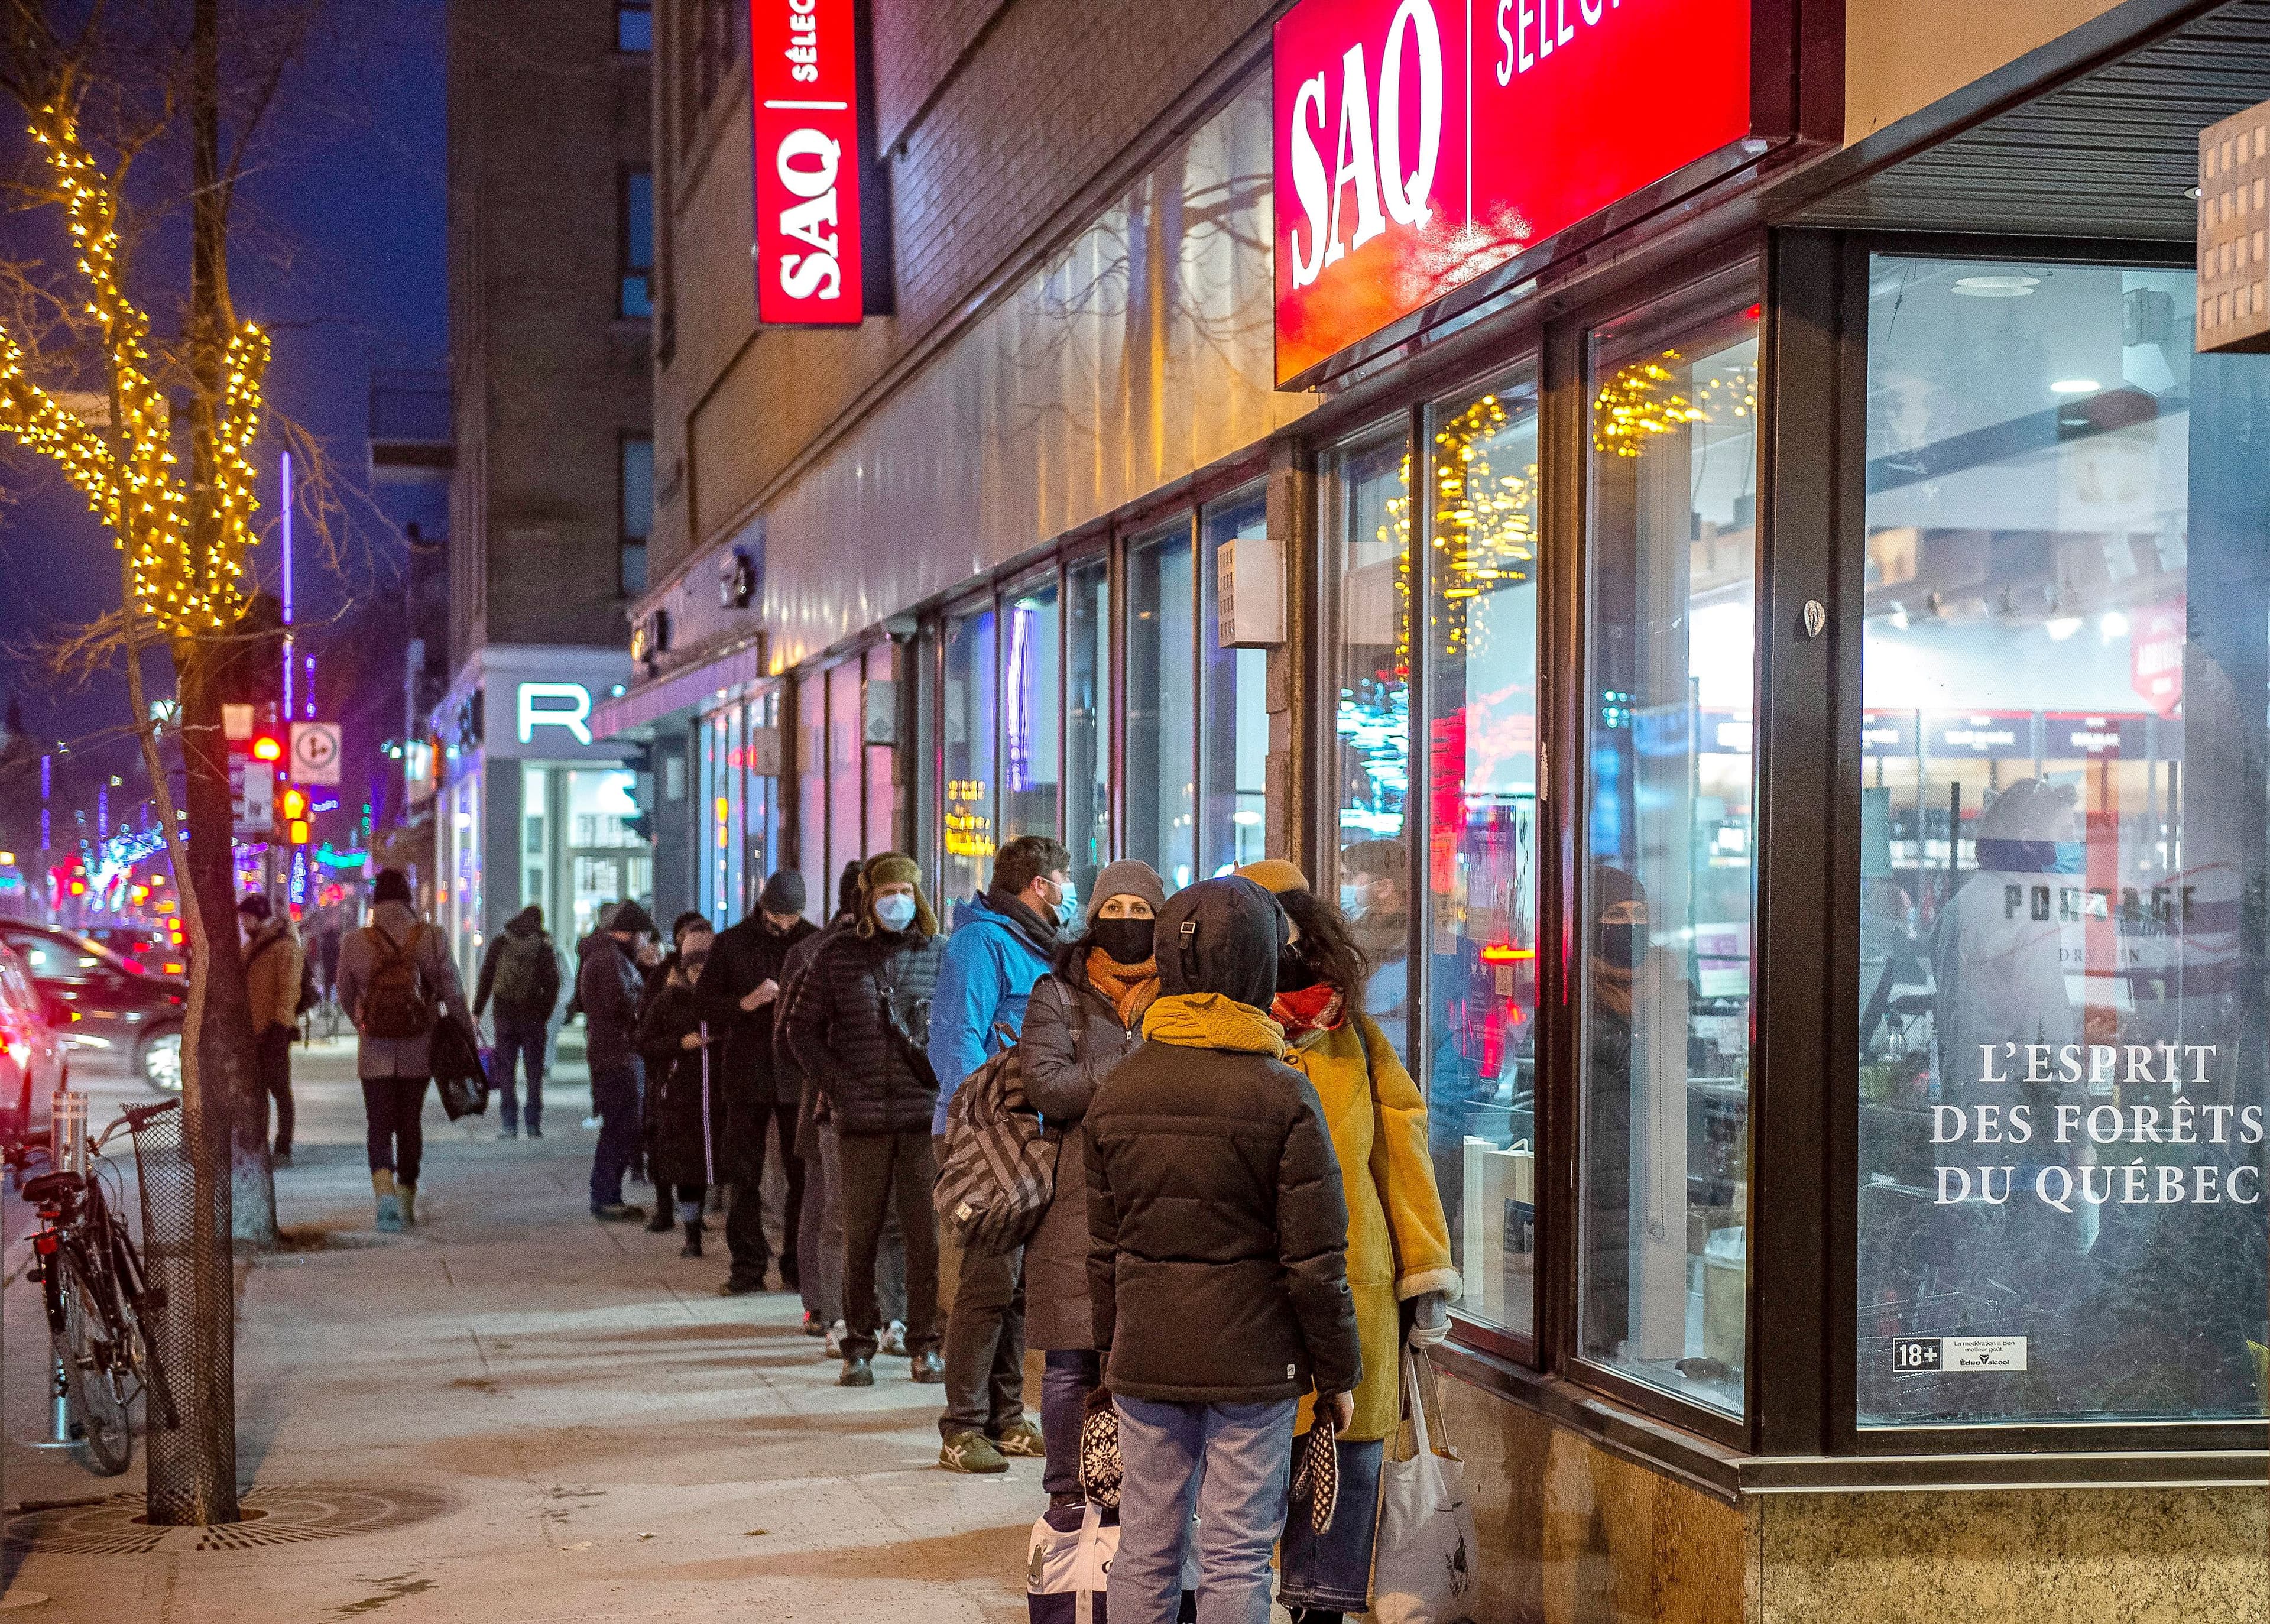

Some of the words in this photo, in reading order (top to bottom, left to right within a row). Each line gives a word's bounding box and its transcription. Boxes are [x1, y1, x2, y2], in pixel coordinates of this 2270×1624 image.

[1291, 0, 1442, 289] SAQ
[776, 128, 841, 300] SAQ
[518, 682, 592, 745] R
[1930, 1104, 2032, 1144] DES
[2054, 1096, 2263, 1144] FORÊTS
[1934, 1166, 2015, 1204] DU
[2035, 1156, 2259, 1213] QUÉBEC
[1899, 1343, 1938, 1366] 18+
